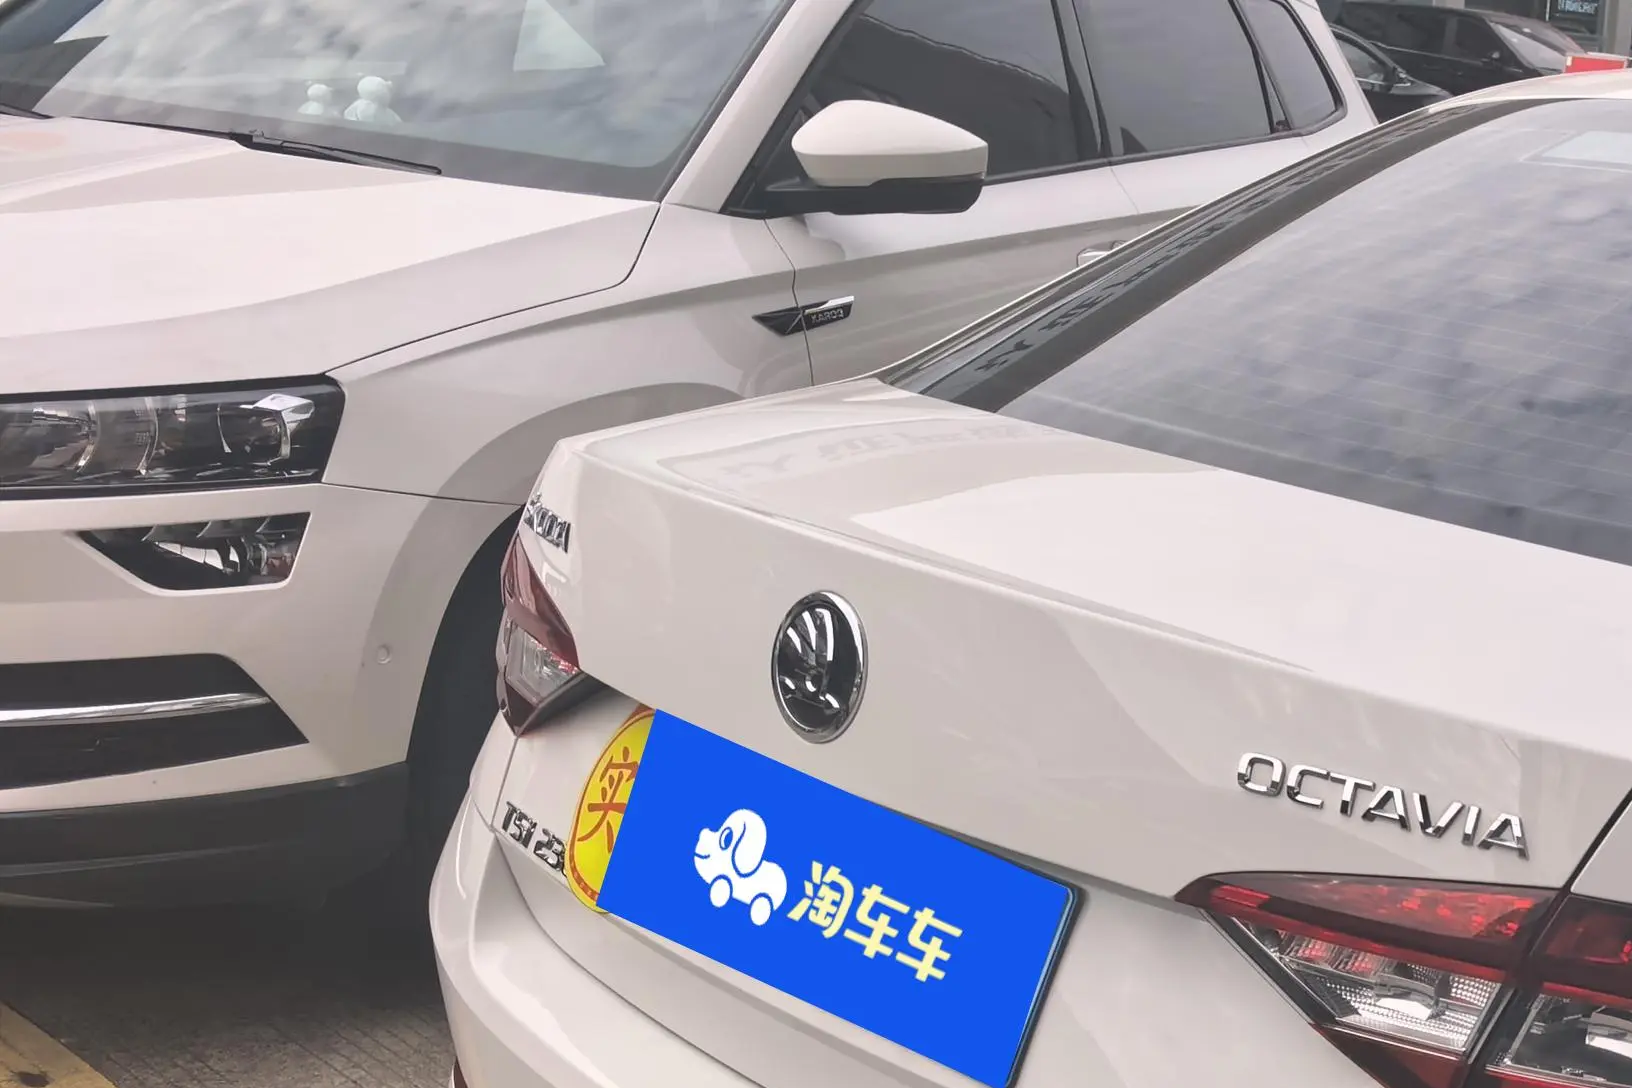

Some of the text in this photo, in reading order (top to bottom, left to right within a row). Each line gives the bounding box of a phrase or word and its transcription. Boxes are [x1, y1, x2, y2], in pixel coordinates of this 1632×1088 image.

[502, 801, 537, 849] TSI
[534, 828, 567, 878] 23
[1237, 752, 1529, 860] OCTAVIA
